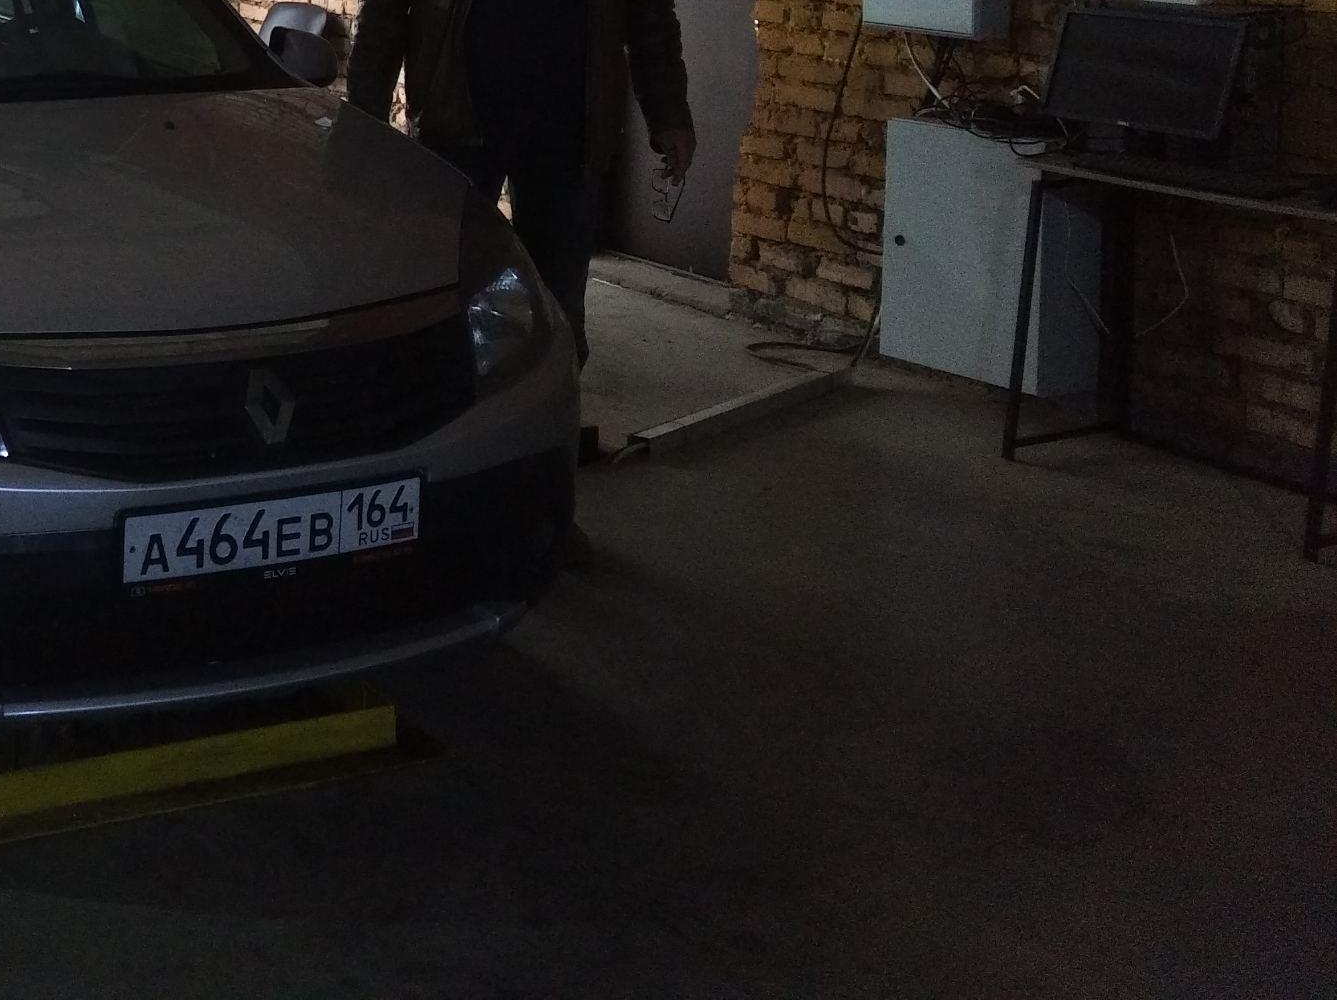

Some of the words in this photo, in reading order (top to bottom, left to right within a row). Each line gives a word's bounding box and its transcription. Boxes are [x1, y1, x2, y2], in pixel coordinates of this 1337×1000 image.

[347, 485, 408, 530] 164
[141, 510, 334, 575] А464ЕВ
[359, 528, 390, 546] RUS
